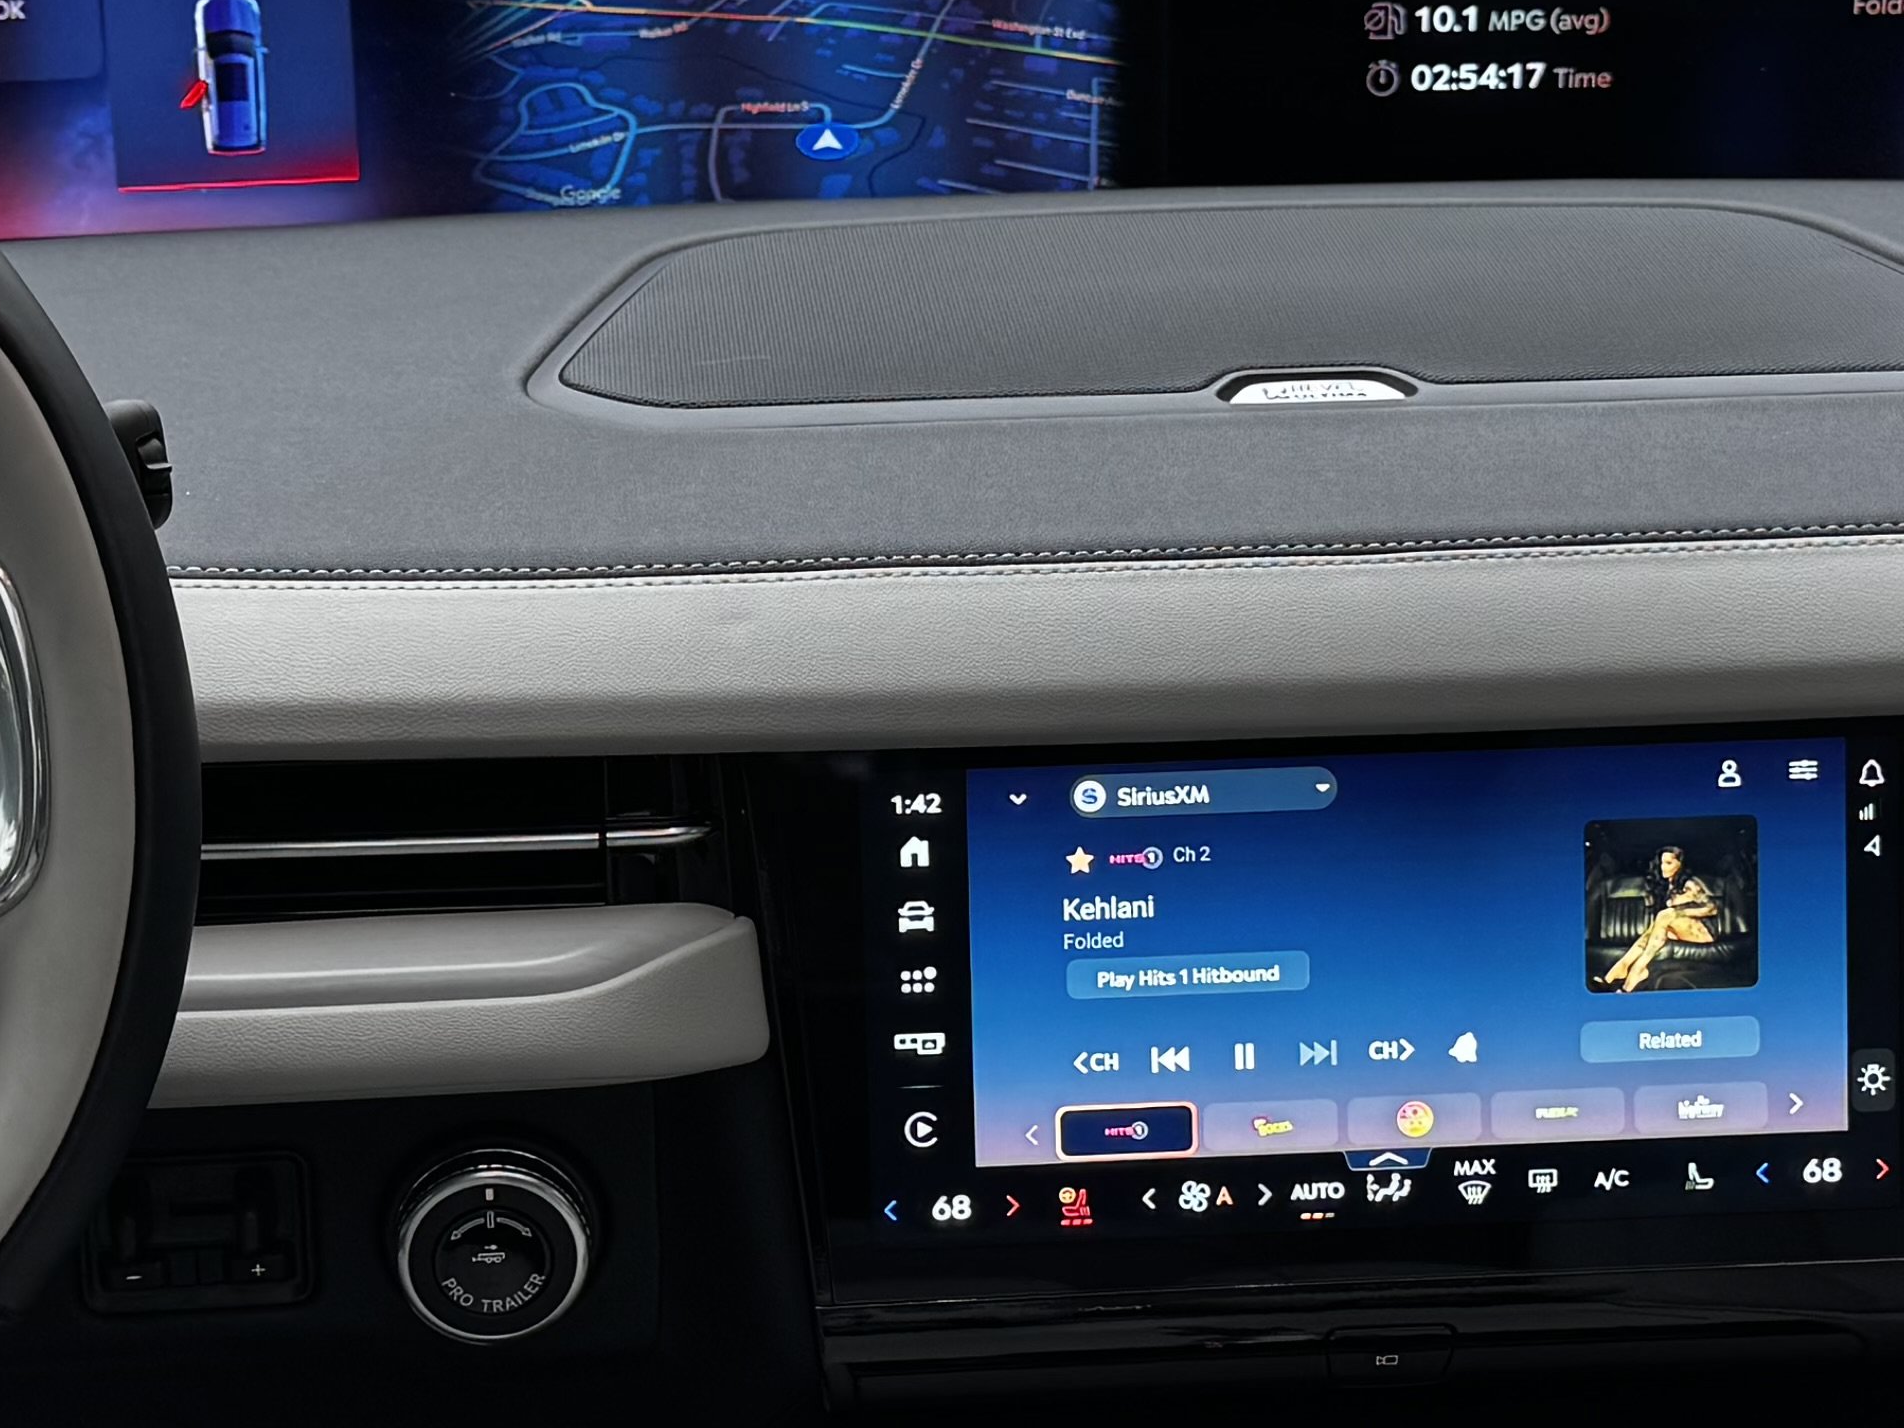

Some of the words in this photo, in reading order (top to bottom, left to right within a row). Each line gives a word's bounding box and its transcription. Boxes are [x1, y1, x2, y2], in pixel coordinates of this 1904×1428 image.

[1415, 6, 1479, 34] 10.1
[1488, 9, 1546, 35] MPG
[1549, 7, 1611, 36] (avg)
[1411, 62, 1547, 92] 02:54:17
[1553, 66, 1614, 90] Time
[891, 793, 942, 816] 1:42
[1117, 785, 1210, 807] SiriusXM
[1173, 846, 1196, 863] Ch
[1199, 845, 1211, 862] 2
[1062, 894, 1155, 922] Kehlani
[1062, 931, 1125, 951] Folded
[1097, 968, 1135, 990] Play
[1139, 967, 1176, 987] Hits
[1179, 967, 1189, 985] 1
[1193, 964, 1280, 985] Hitbound
[1639, 1030, 1703, 1051] Related
[1453, 1158, 1496, 1176] MAX
[1802, 1158, 1843, 1183] 68
[1593, 1169, 1630, 1190] A/C
[1215, 1185, 1234, 1207] A
[1290, 1181, 1345, 1201] AUTO
[931, 1194, 972, 1221] 68
[441, 1277, 474, 1307] PRO
[481, 1273, 546, 1313] TRAILER
